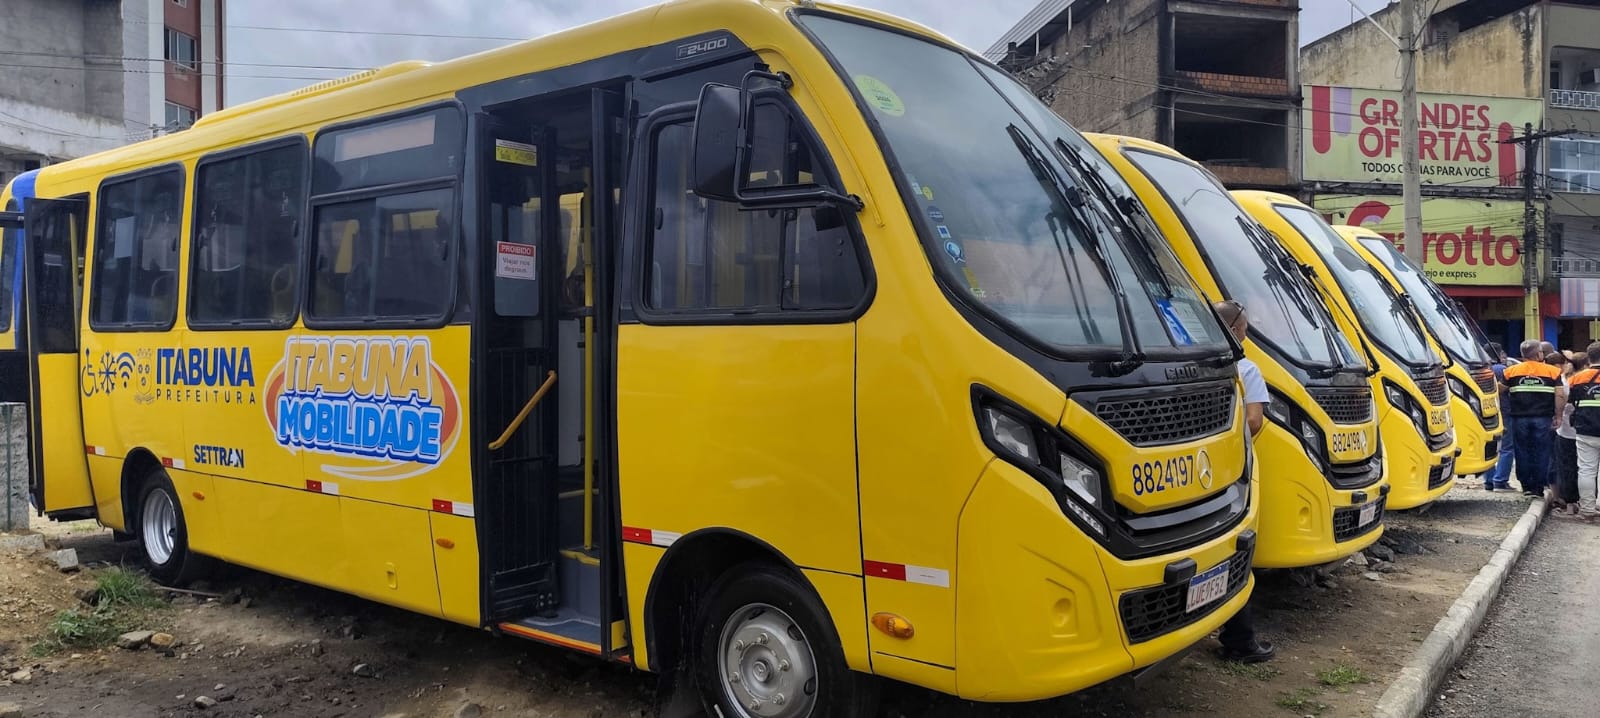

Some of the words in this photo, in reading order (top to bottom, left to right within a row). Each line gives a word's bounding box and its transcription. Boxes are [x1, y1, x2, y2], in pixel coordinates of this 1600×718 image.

[1360, 98, 1490, 131] GRNDES
[1358, 126, 1492, 162] OFRTAS
[1362, 162, 1396, 173] TODOS
[1437, 166, 1461, 176] PARA
[1464, 166, 1490, 177] VOCÊ
[1446, 270, 1477, 280] express
[157, 347, 255, 387] ITABUNA
[286, 342, 431, 400] ITABUNA
[156, 388, 256, 404] PREFEITURA
[279, 399, 441, 456] MOBILIDADE
[194, 444, 245, 468] SETTRAN
[1132, 455, 1194, 496] 8824197
